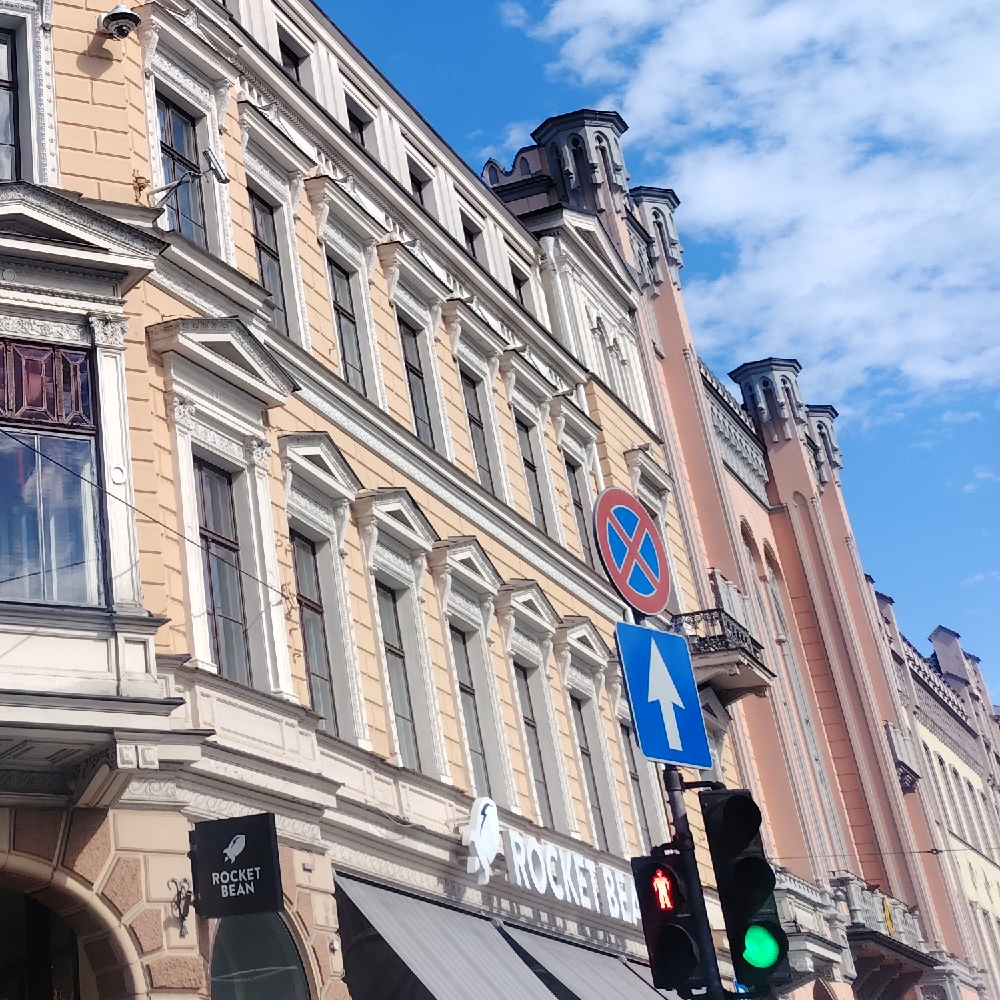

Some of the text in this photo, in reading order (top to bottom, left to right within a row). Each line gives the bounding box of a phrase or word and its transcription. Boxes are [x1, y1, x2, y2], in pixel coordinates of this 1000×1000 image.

[211, 866, 261, 886] ROCKET
[508, 829, 601, 914] ROCKET
[220, 881, 255, 898] BEAN
